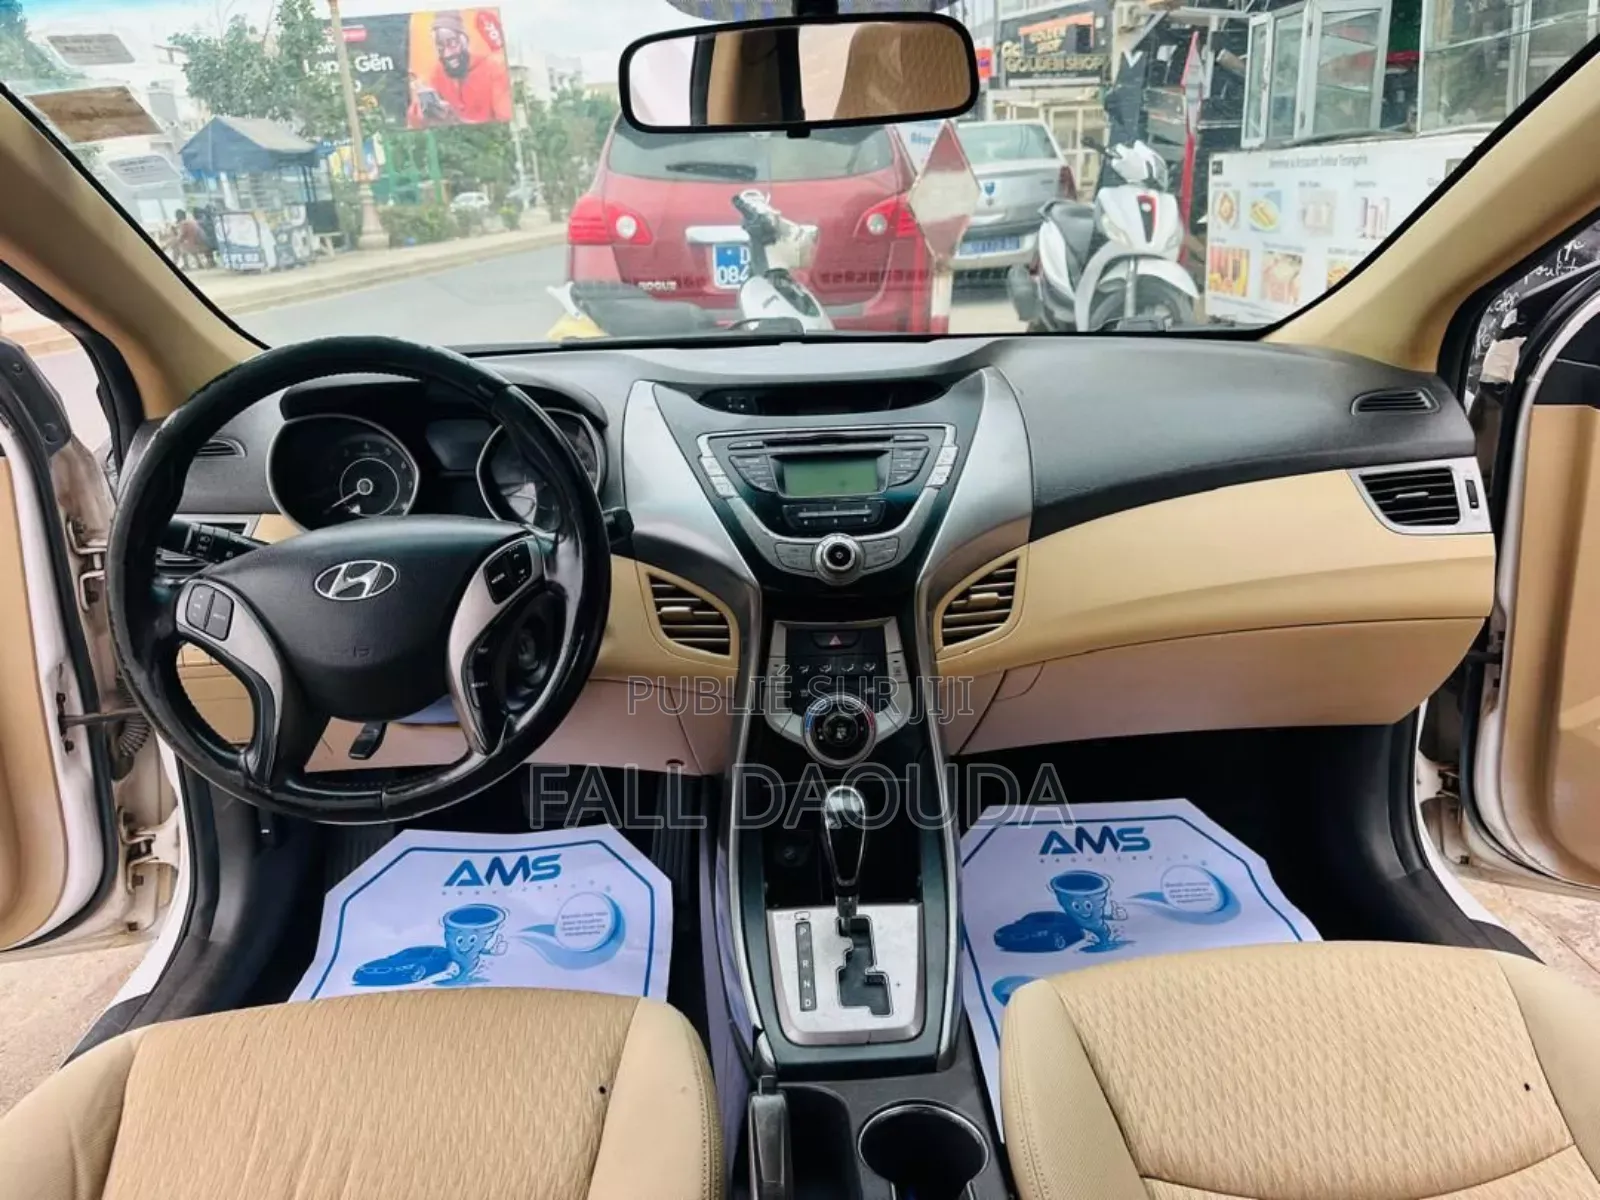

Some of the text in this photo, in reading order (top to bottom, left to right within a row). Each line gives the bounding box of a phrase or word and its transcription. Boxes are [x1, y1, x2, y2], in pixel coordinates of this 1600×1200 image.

[354, 53, 394, 73] Gën
[1038, 825, 1152, 856] AMS
[443, 852, 562, 887] AMS
[802, 959, 809, 969] R
[804, 979, 811, 989] N
[805, 998, 812, 1007] D
